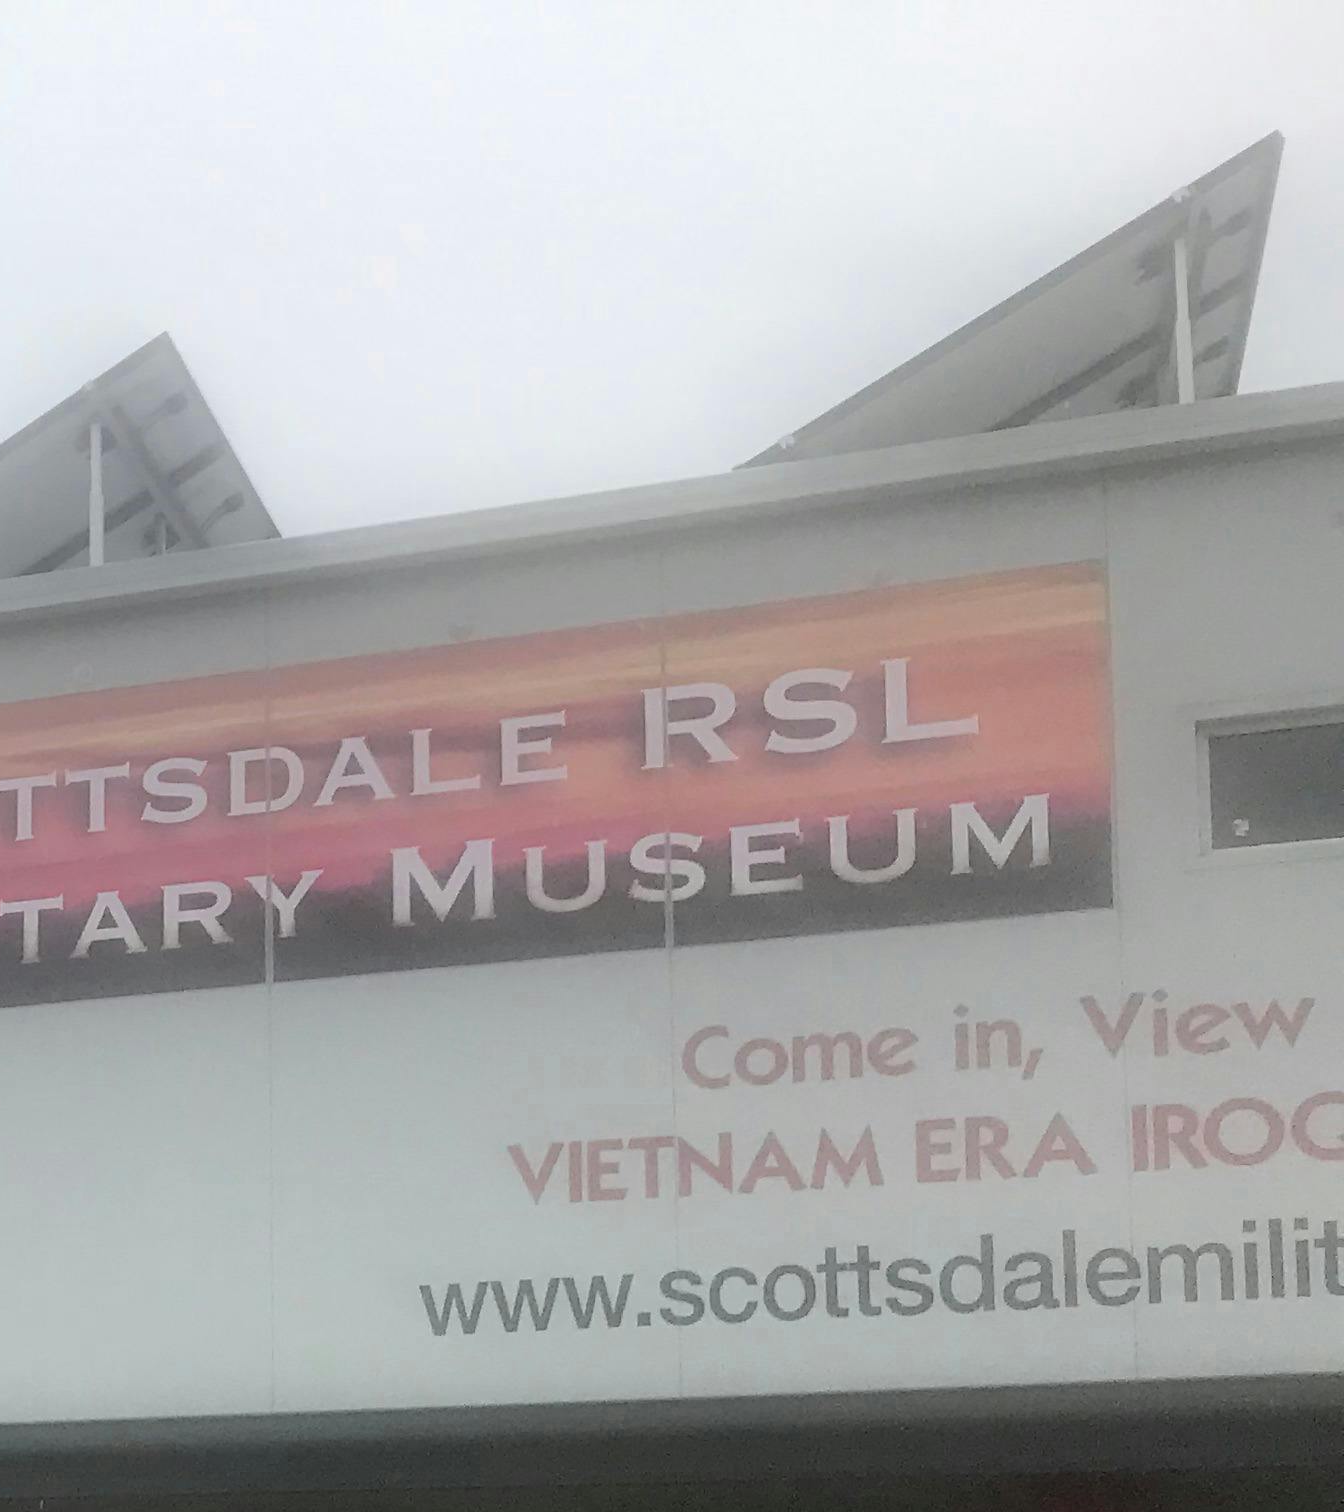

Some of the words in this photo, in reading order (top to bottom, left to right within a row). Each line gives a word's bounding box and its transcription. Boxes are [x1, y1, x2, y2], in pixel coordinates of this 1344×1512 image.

[640, 656, 981, 773] RSL
[390, 791, 1055, 928] MUSEUM
[682, 1022, 917, 1091] Come
[954, 1004, 1044, 1080] in,
[1079, 988, 1316, 1060] View
[507, 1125, 886, 1206] VIETNAM
[914, 1112, 1098, 1184] ERA
